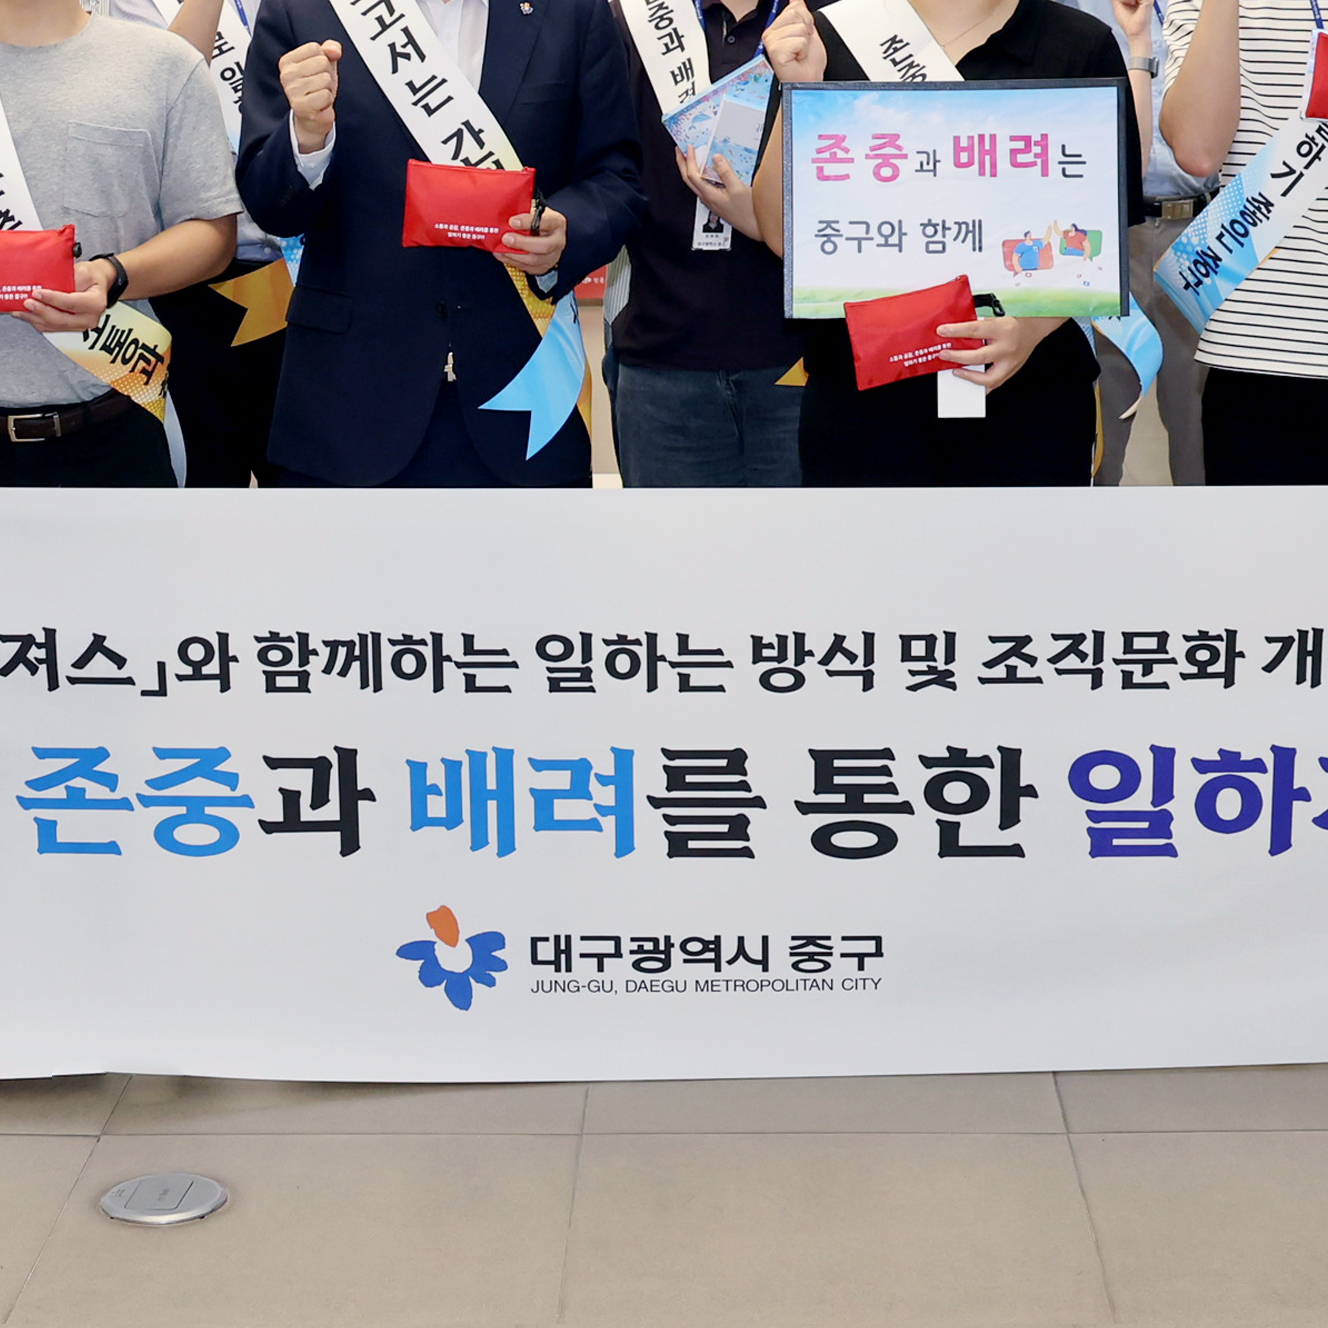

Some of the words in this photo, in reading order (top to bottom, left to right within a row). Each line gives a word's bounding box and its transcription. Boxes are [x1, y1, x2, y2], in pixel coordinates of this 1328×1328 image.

[815, 219, 907, 255] 중구와
[920, 218, 983, 254] 함께
[1216, 192, 1275, 254] 좋은
[1178, 246, 1224, 296] 중구
[253, 630, 520, 694] 함께하는
[535, 631, 734, 694] 일하는
[750, 630, 876, 694] 방식
[898, 630, 958, 693] 및
[977, 628, 1246, 691] 조직문화
[15, 745, 377, 858] 존중과
[405, 746, 768, 860] 배려를
[793, 745, 1039, 860] 통한
[530, 934, 769, 974] 대구광역시
[788, 935, 884, 974] 중구
[530, 979, 618, 995] JUNG-GU,
[625, 979, 687, 993] DAEGU
[695, 978, 834, 993] METROPOLITAN
[841, 977, 882, 991] CITY
